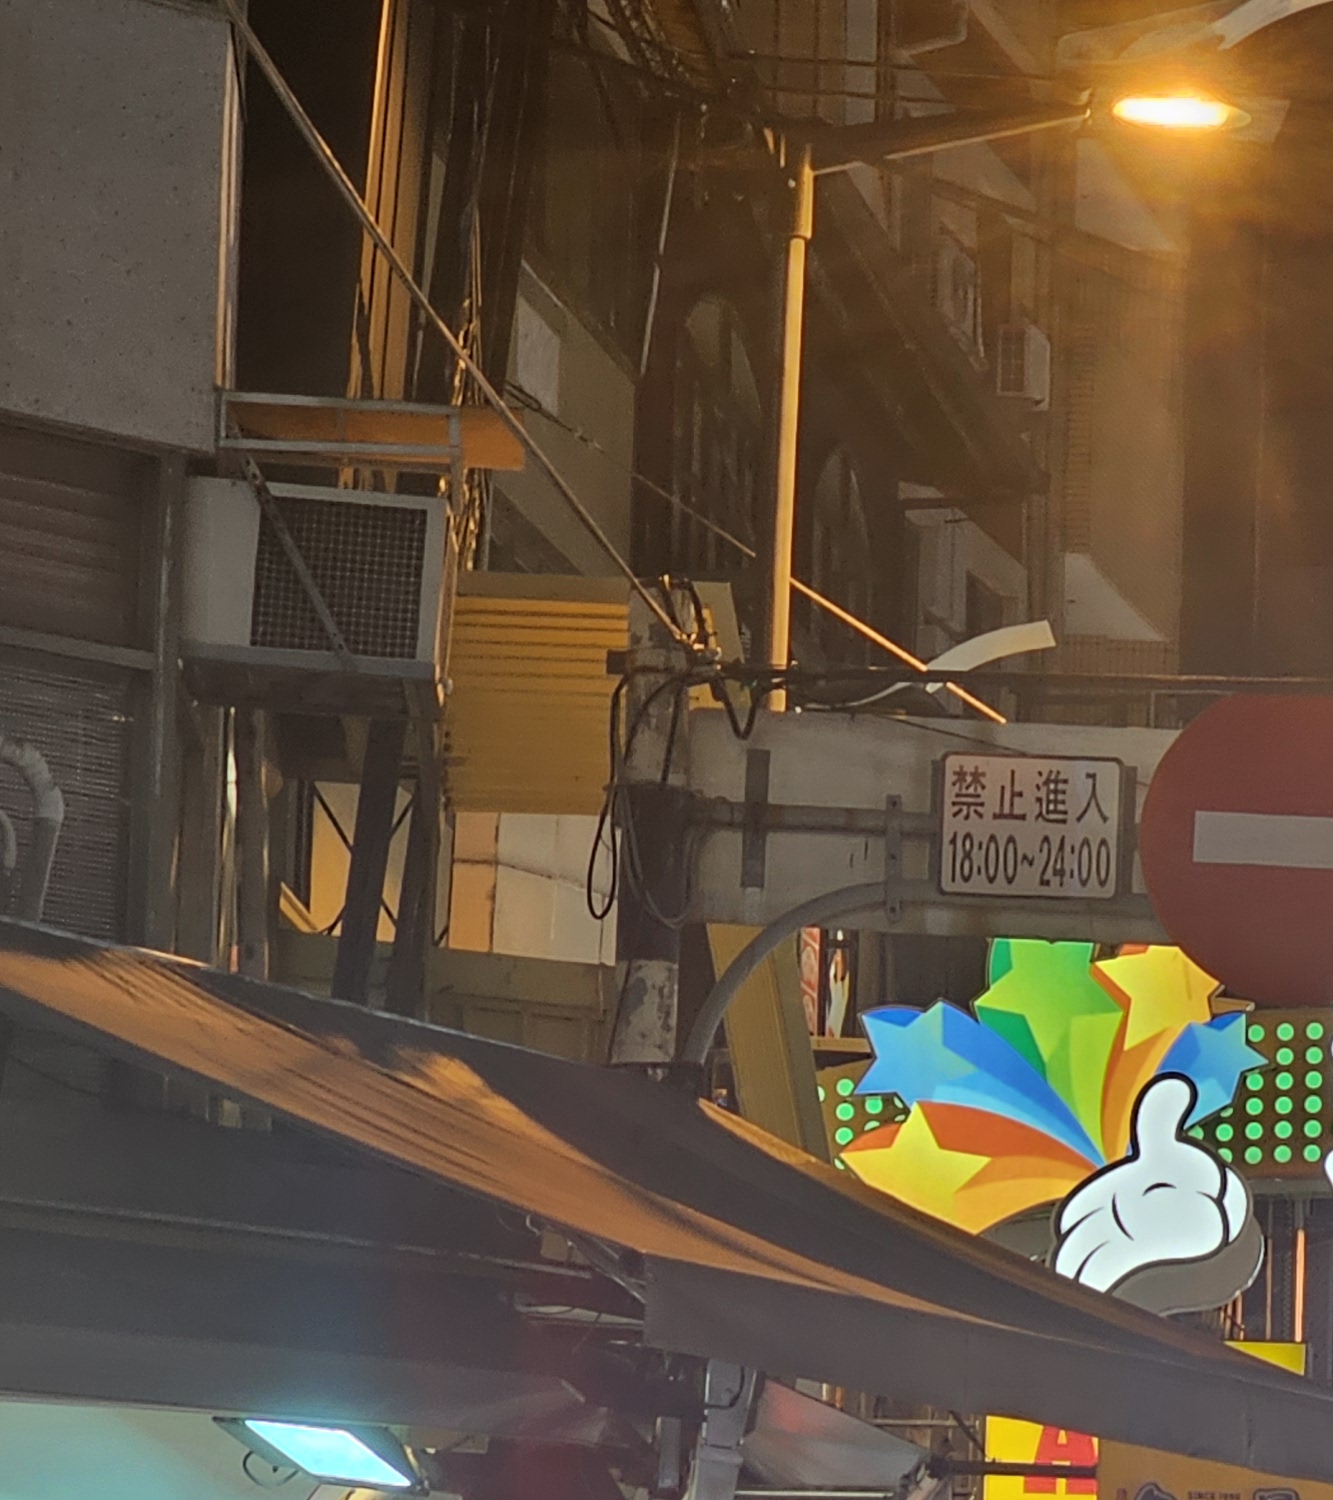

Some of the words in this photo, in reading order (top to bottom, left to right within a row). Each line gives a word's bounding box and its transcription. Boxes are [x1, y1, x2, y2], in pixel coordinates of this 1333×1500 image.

[951, 765, 1110, 826] 禁止進入
[949, 832, 1111, 889] 18:00~24:00
